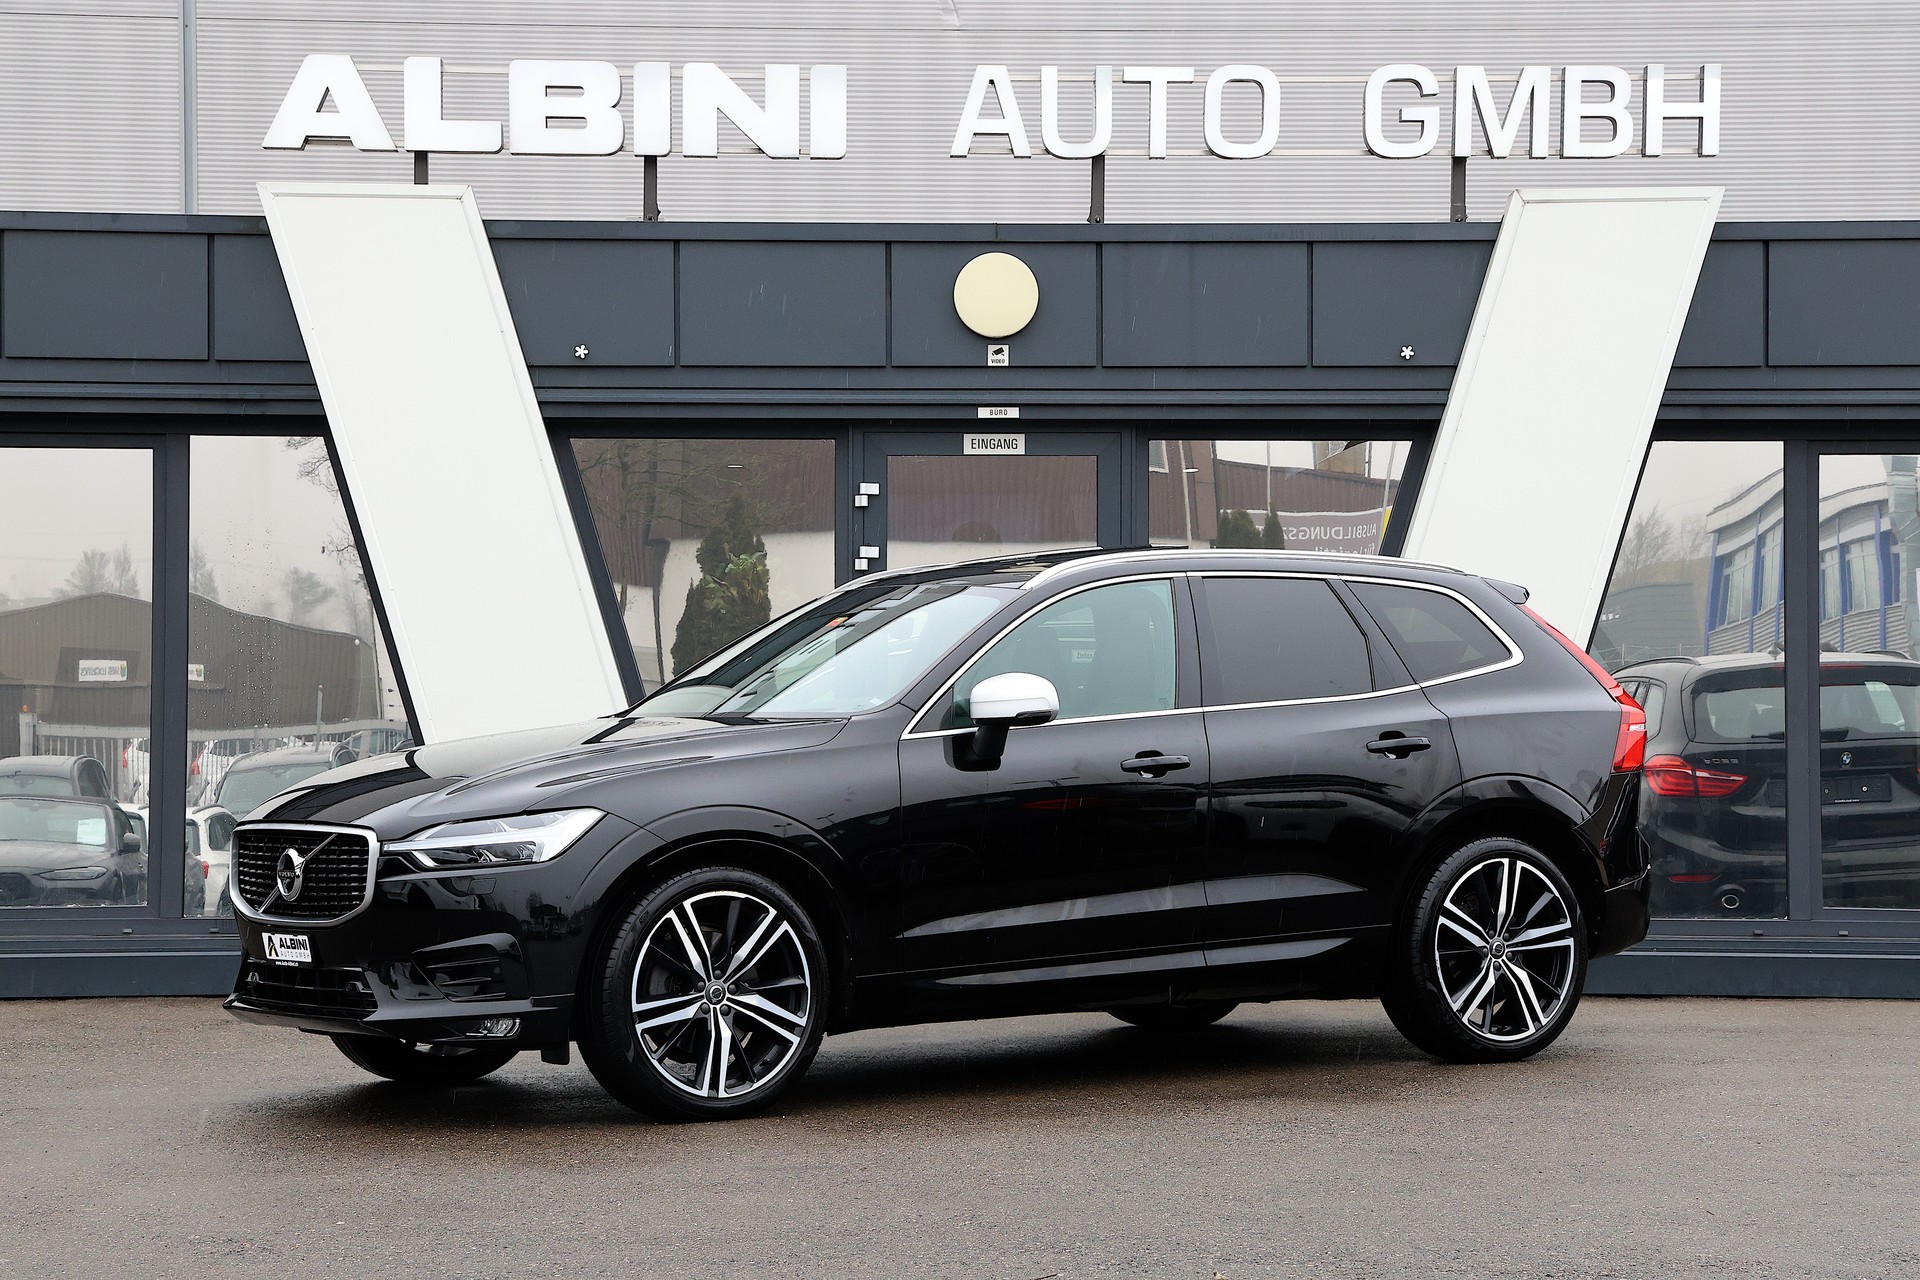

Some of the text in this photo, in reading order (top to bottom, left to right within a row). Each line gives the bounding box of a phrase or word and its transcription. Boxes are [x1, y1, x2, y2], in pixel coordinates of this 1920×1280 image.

[262, 54, 1722, 160] ALBINI AUTO GMBH
[989, 407, 1008, 416] BÜRO
[971, 438, 1018, 450] EINGANG
[279, 937, 308, 951] ALBINI
